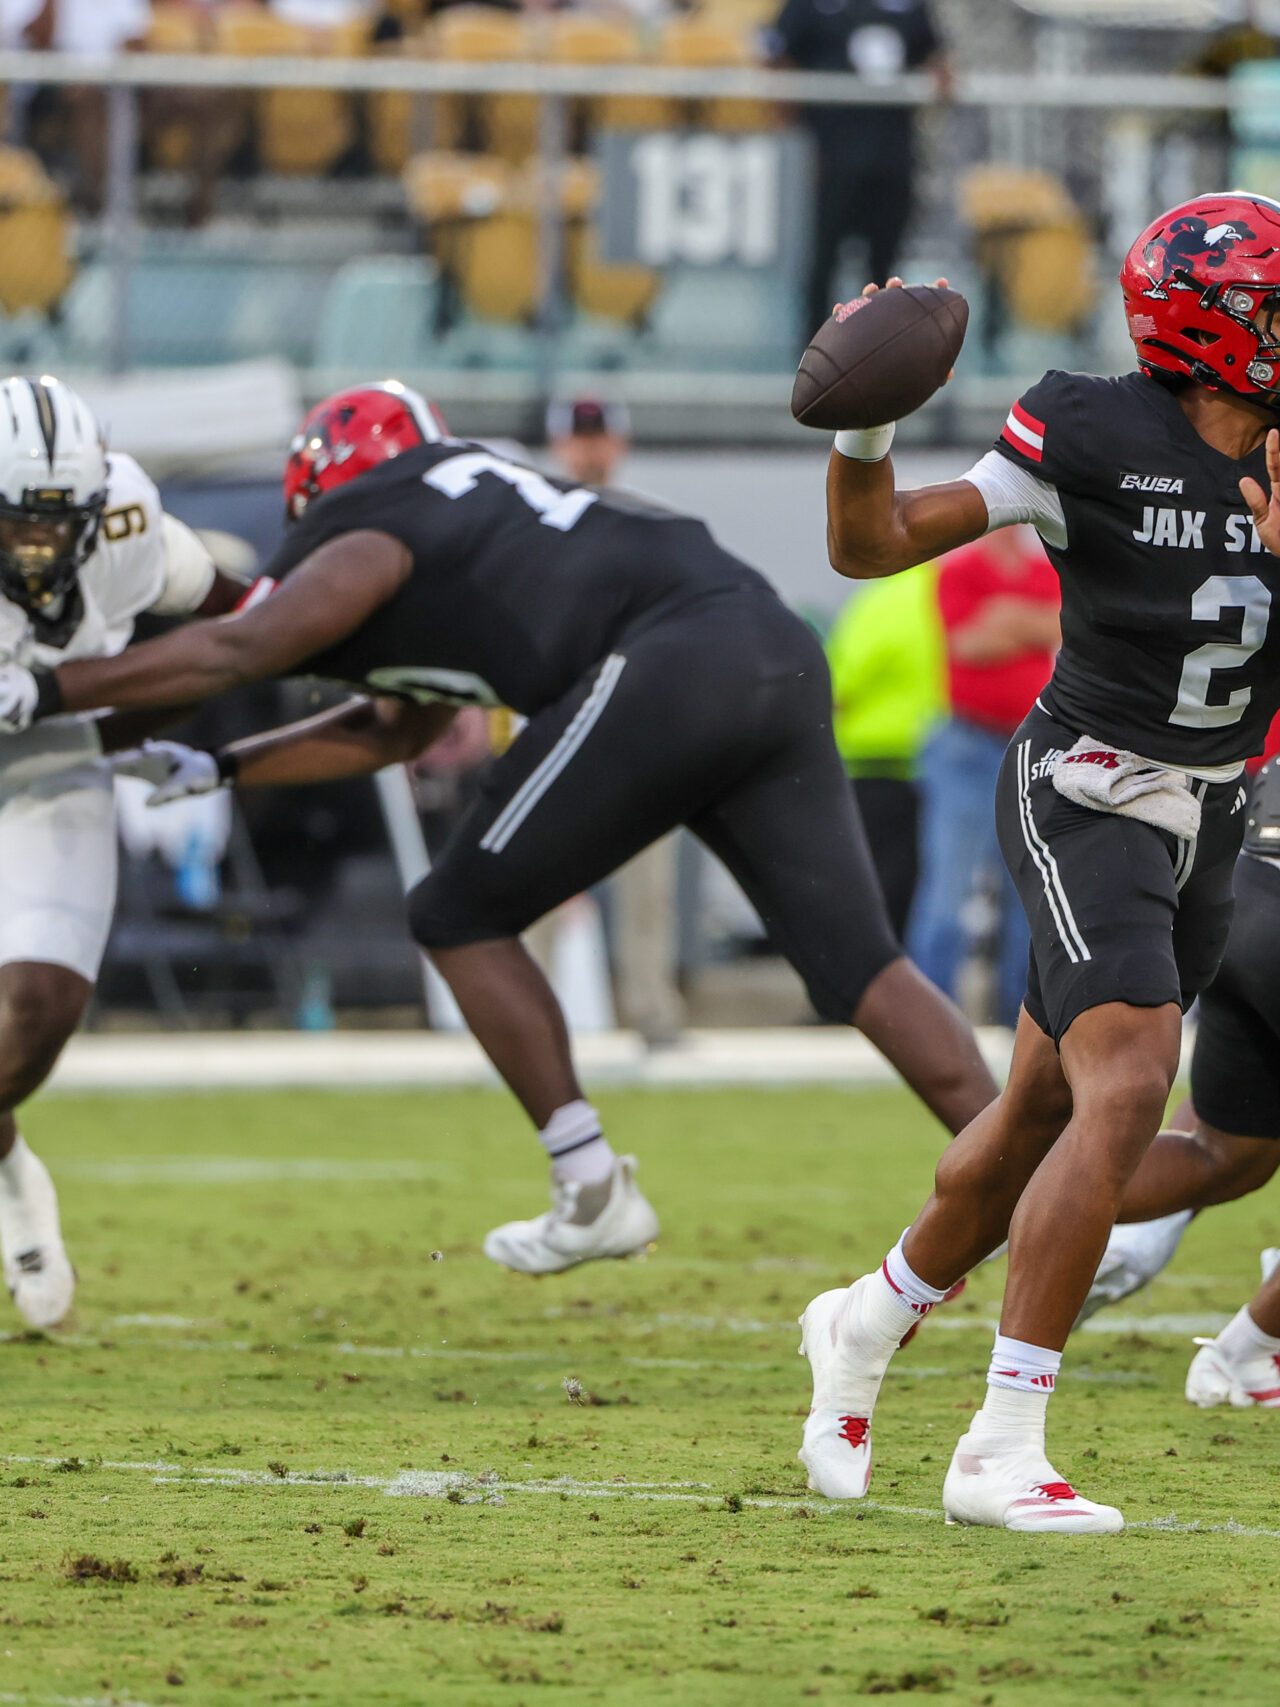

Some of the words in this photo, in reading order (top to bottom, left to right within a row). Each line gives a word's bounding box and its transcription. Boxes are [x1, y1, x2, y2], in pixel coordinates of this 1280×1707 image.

[634, 134, 779, 264] 131
[1132, 506, 1207, 550] JAX
[1168, 575, 1272, 729] 2
[1031, 760, 1056, 781] STA
